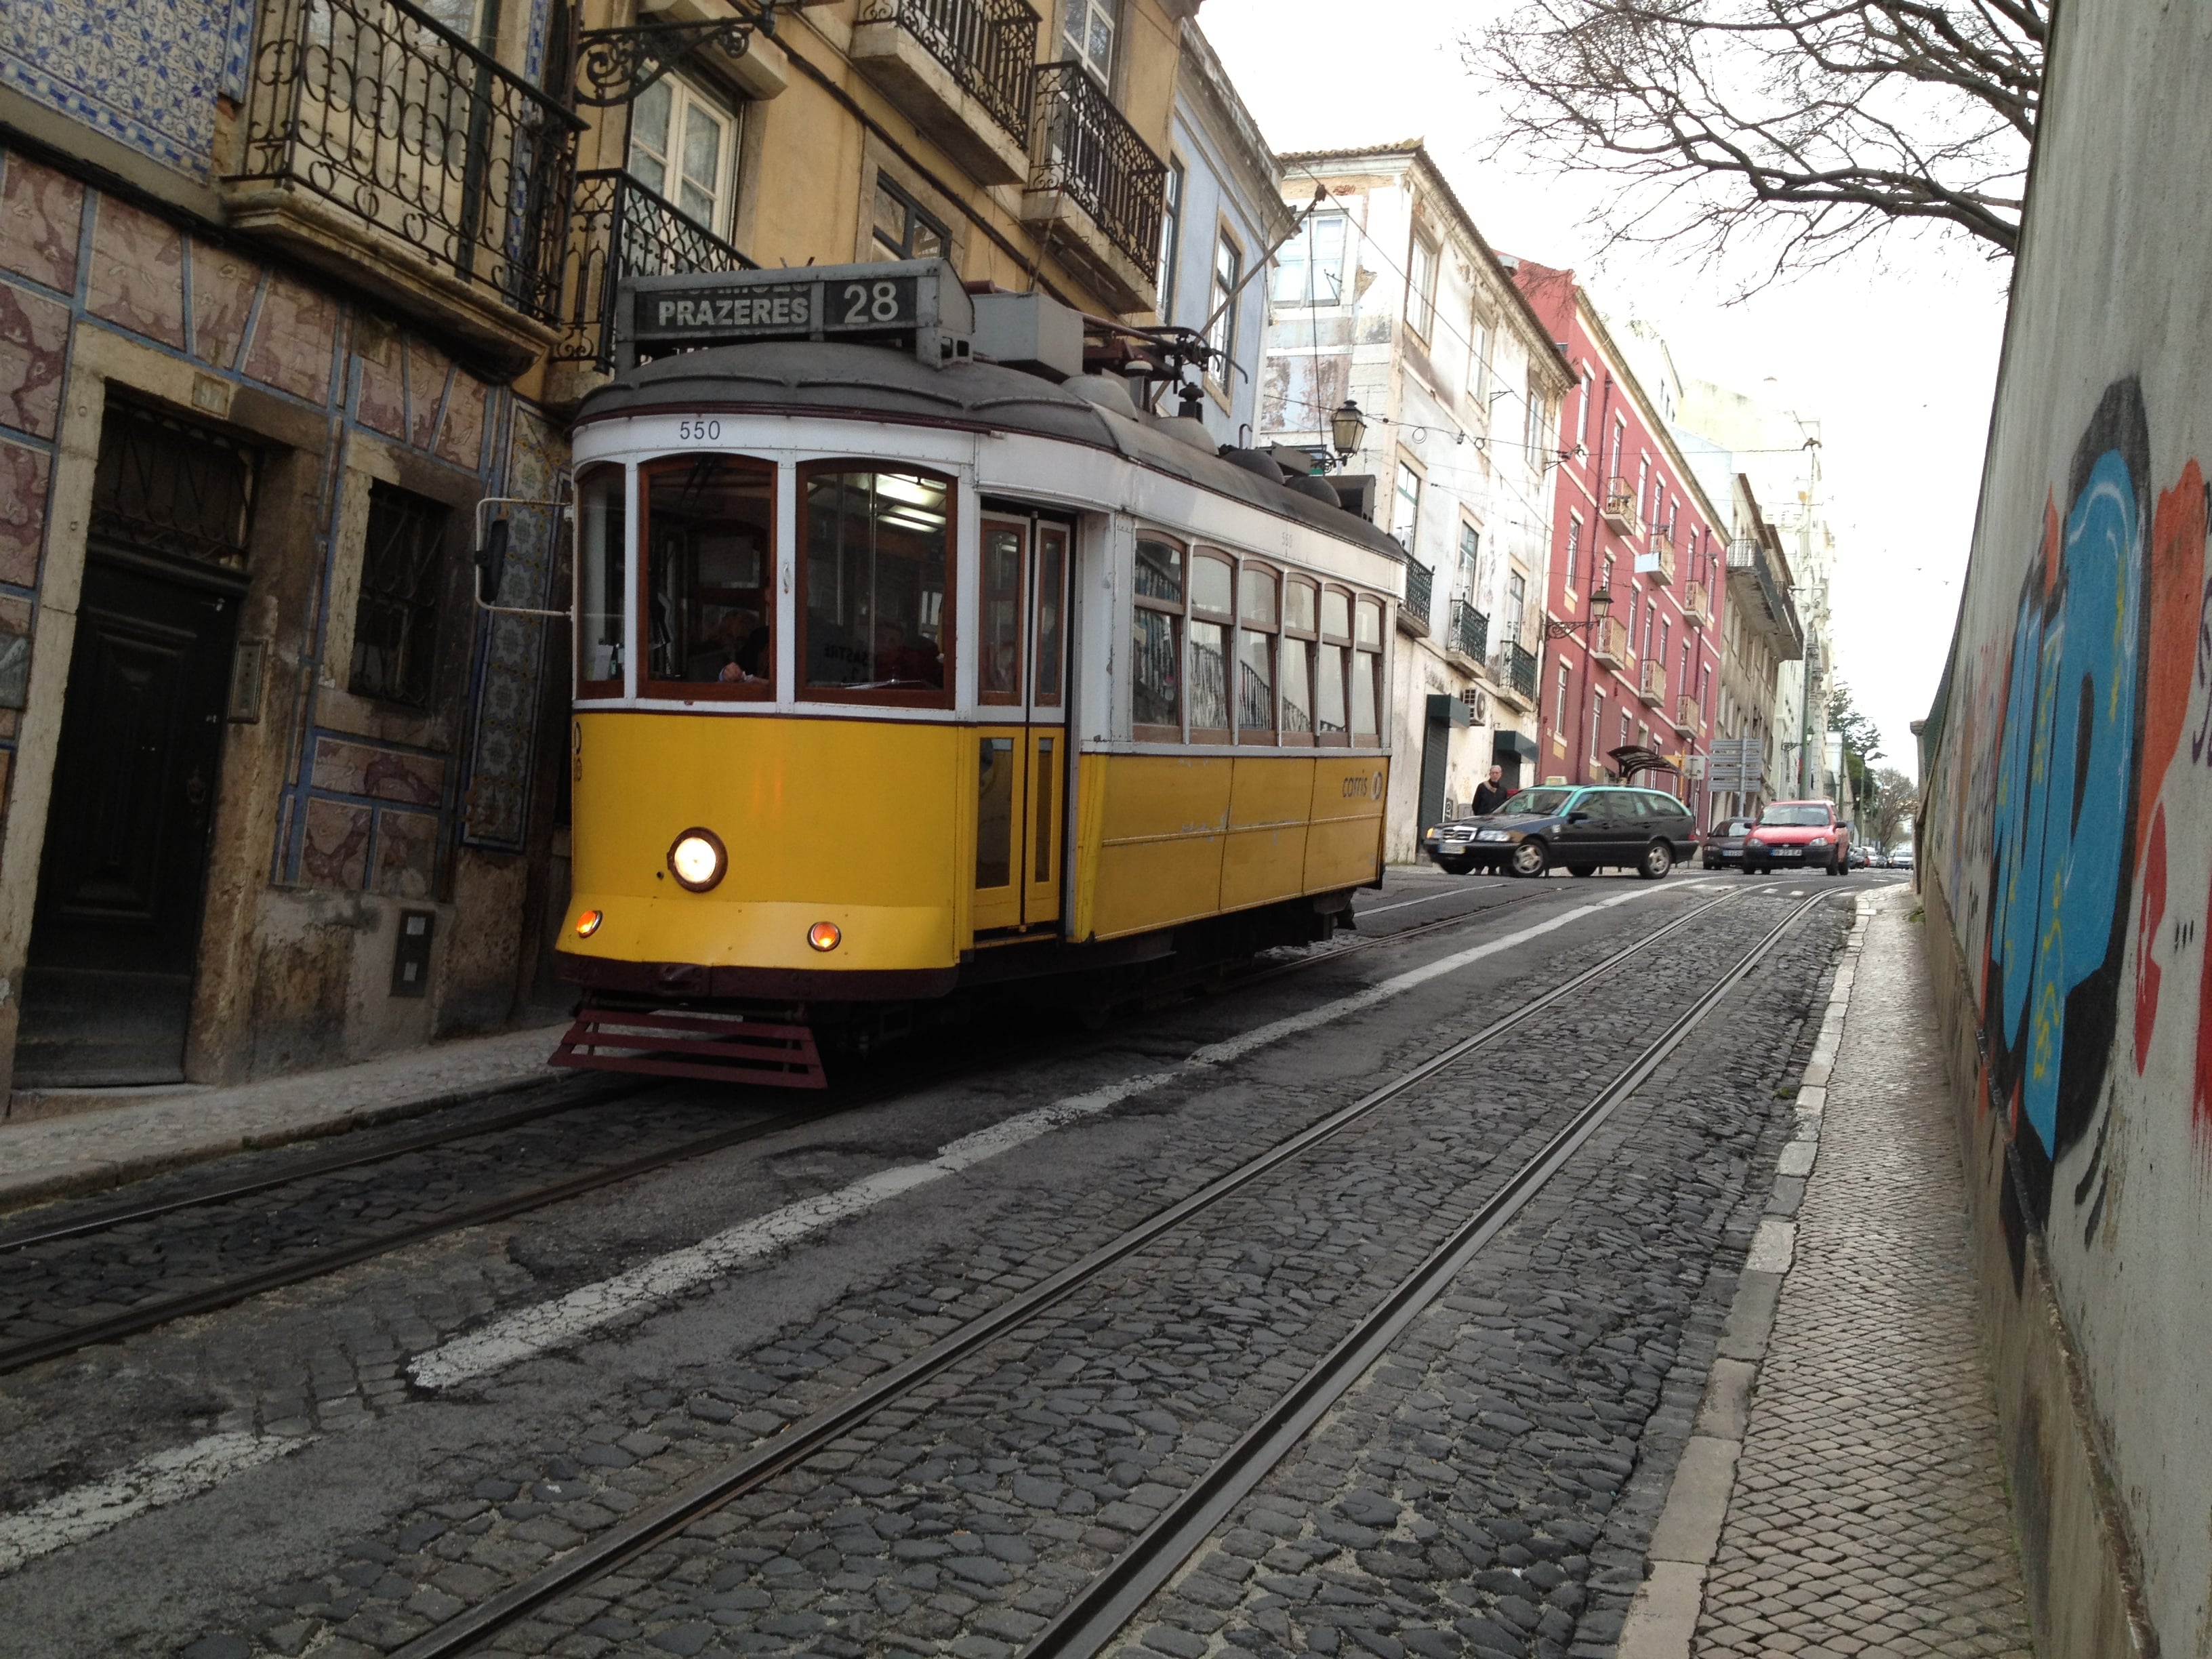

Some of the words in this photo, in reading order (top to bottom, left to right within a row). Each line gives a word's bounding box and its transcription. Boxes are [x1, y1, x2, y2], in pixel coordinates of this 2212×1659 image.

[658, 297, 809, 326] PRAZERES
[843, 281, 899, 323] 28
[680, 420, 720, 440] 550
[1342, 769, 1368, 798] carris
